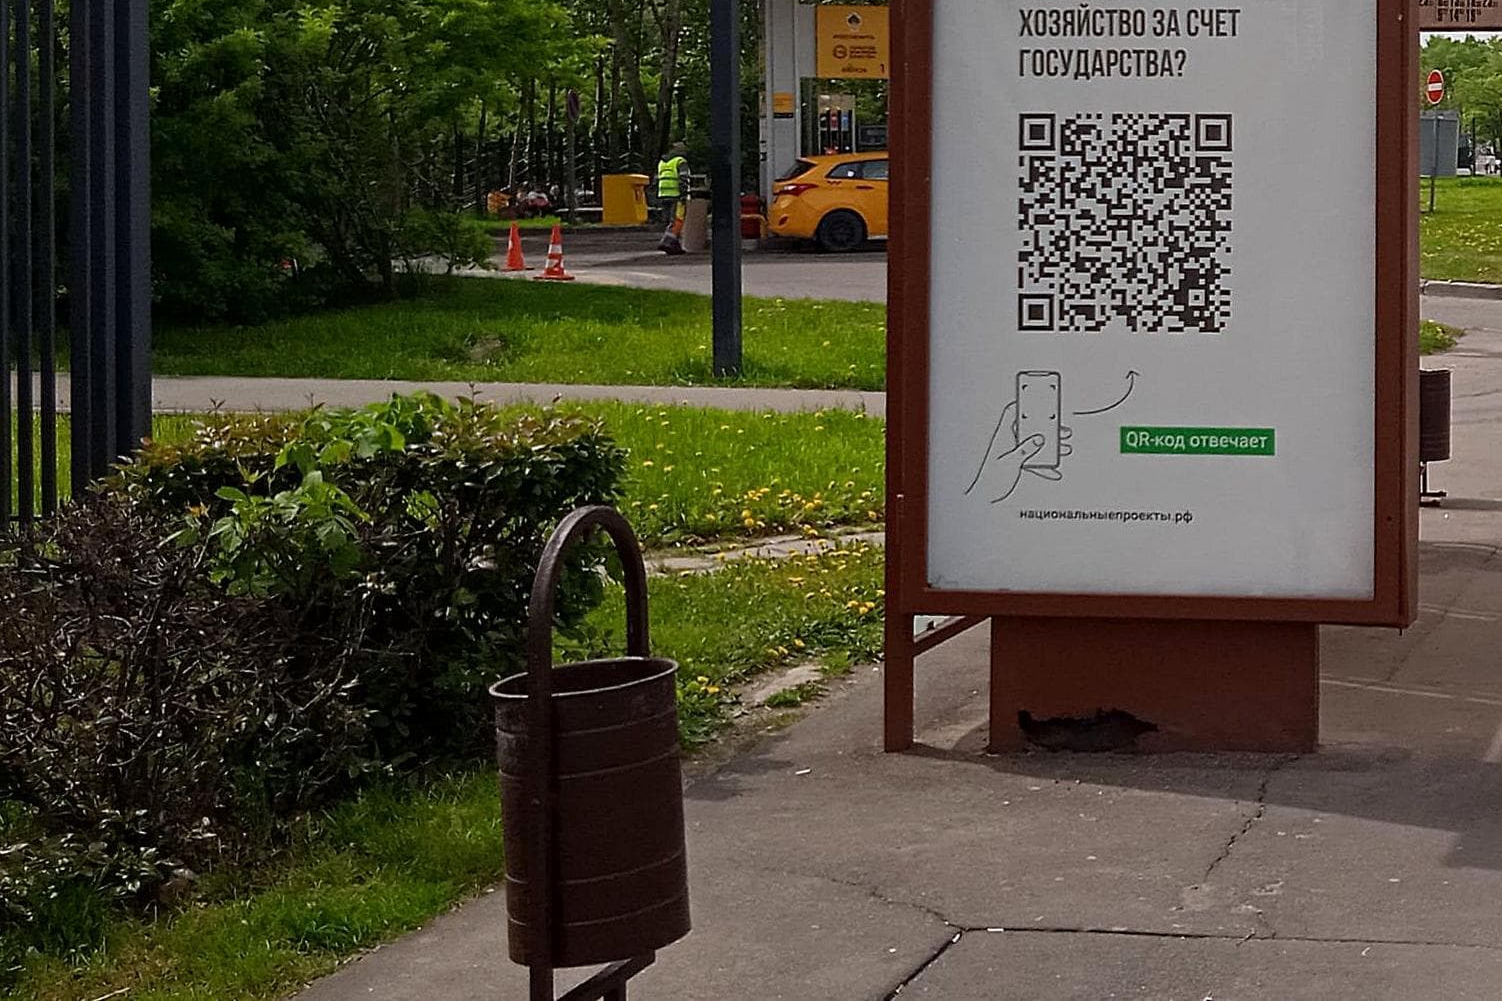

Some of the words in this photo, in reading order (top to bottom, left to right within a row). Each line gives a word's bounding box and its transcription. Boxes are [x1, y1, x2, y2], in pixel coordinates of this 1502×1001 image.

[1019, 3, 1145, 37] ХОЗЯЙСТВО
[1152, 9, 1181, 37] ЗА
[1186, 9, 1241, 37] СЧЕТ
[1019, 48, 1187, 80] ГОСУДАРСТВА?
[1126, 431, 1185, 450] QR-код
[1189, 434, 1268, 449] отвечает
[1019, 509, 1193, 524] национальныепроекты.рф
